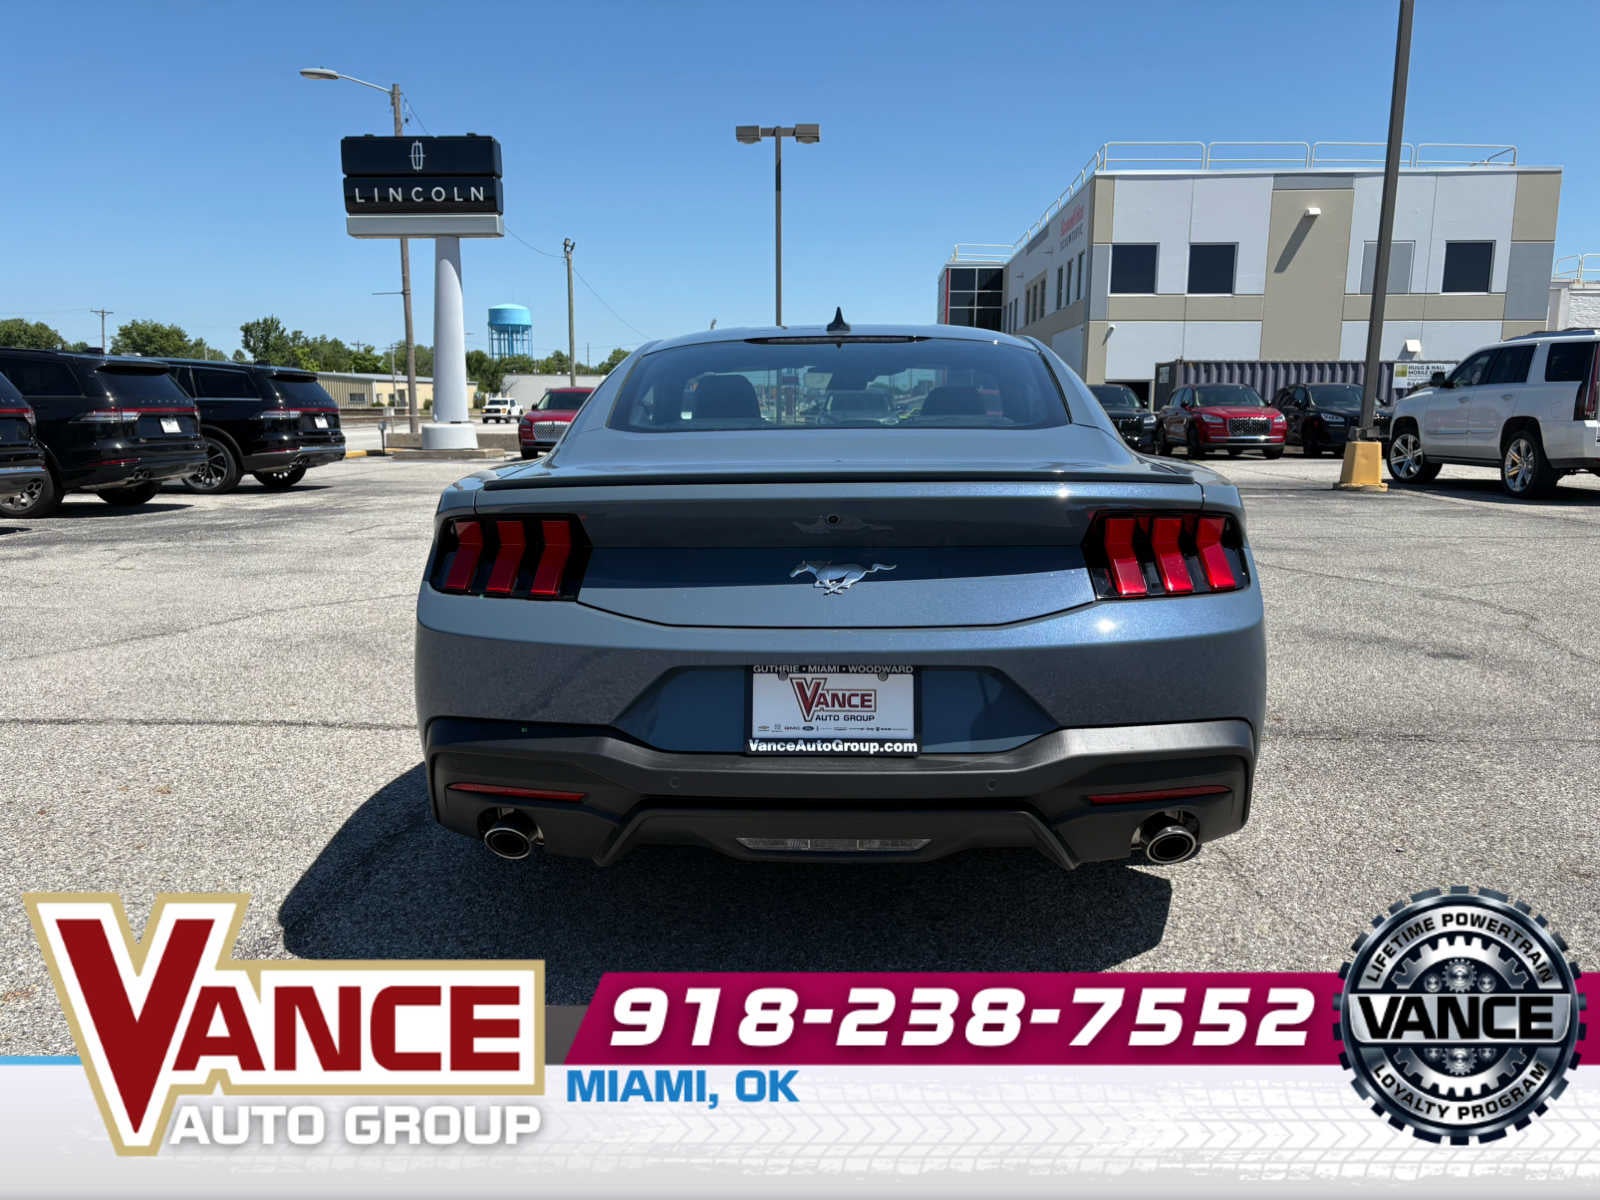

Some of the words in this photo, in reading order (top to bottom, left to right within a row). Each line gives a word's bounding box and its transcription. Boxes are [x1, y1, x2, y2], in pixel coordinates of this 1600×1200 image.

[355, 186, 484, 203] LINCOLN
[753, 664, 800, 673] GUTHRIE
[807, 664, 840, 673] MIAMI
[848, 664, 914, 673] WOODWARD
[795, 680, 873, 718] VANCE
[815, 714, 840, 722] AUTO
[843, 714, 875, 722] GROUP
[749, 739, 918, 754] VanceAutoGroup.com
